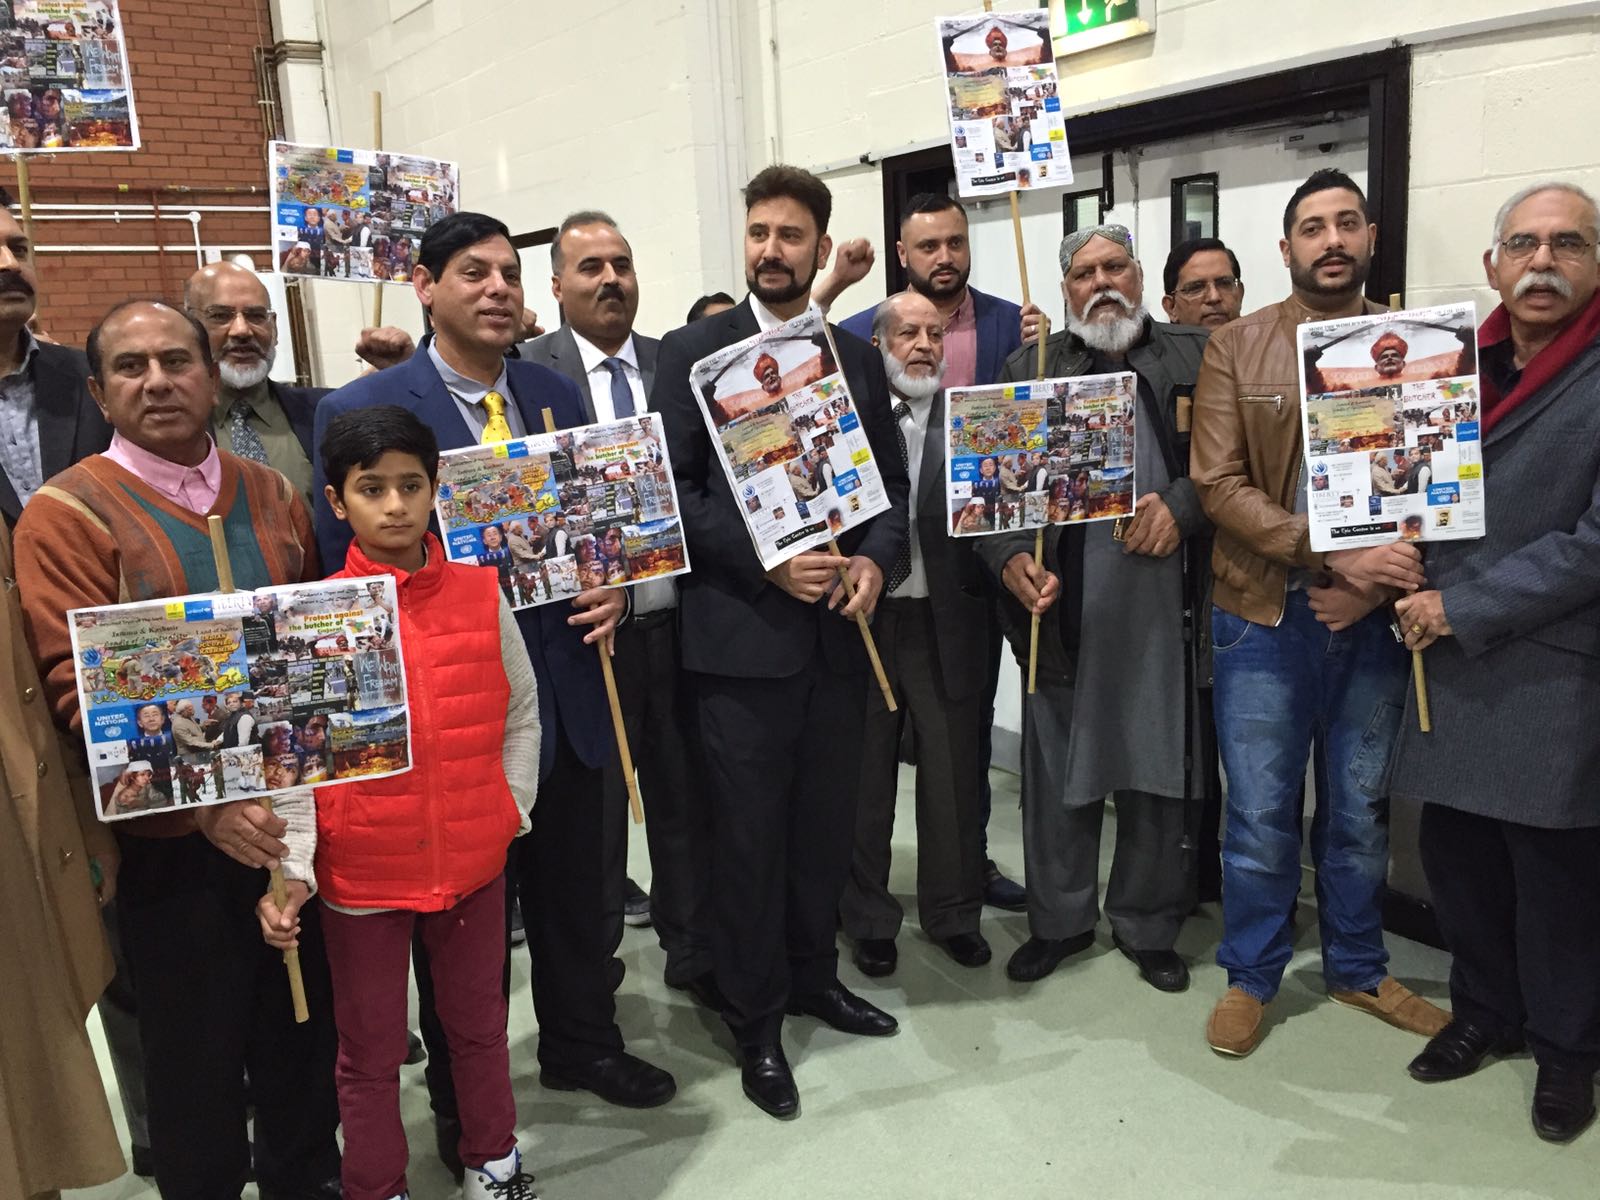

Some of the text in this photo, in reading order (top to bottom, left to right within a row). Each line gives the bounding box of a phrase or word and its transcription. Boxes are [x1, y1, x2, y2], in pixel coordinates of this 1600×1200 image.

[303, 610, 364, 622] Protest against
[304, 621, 333, 630] butcher
[96, 713, 125, 721] UNITED
[94, 718, 129, 726] NATIONS
